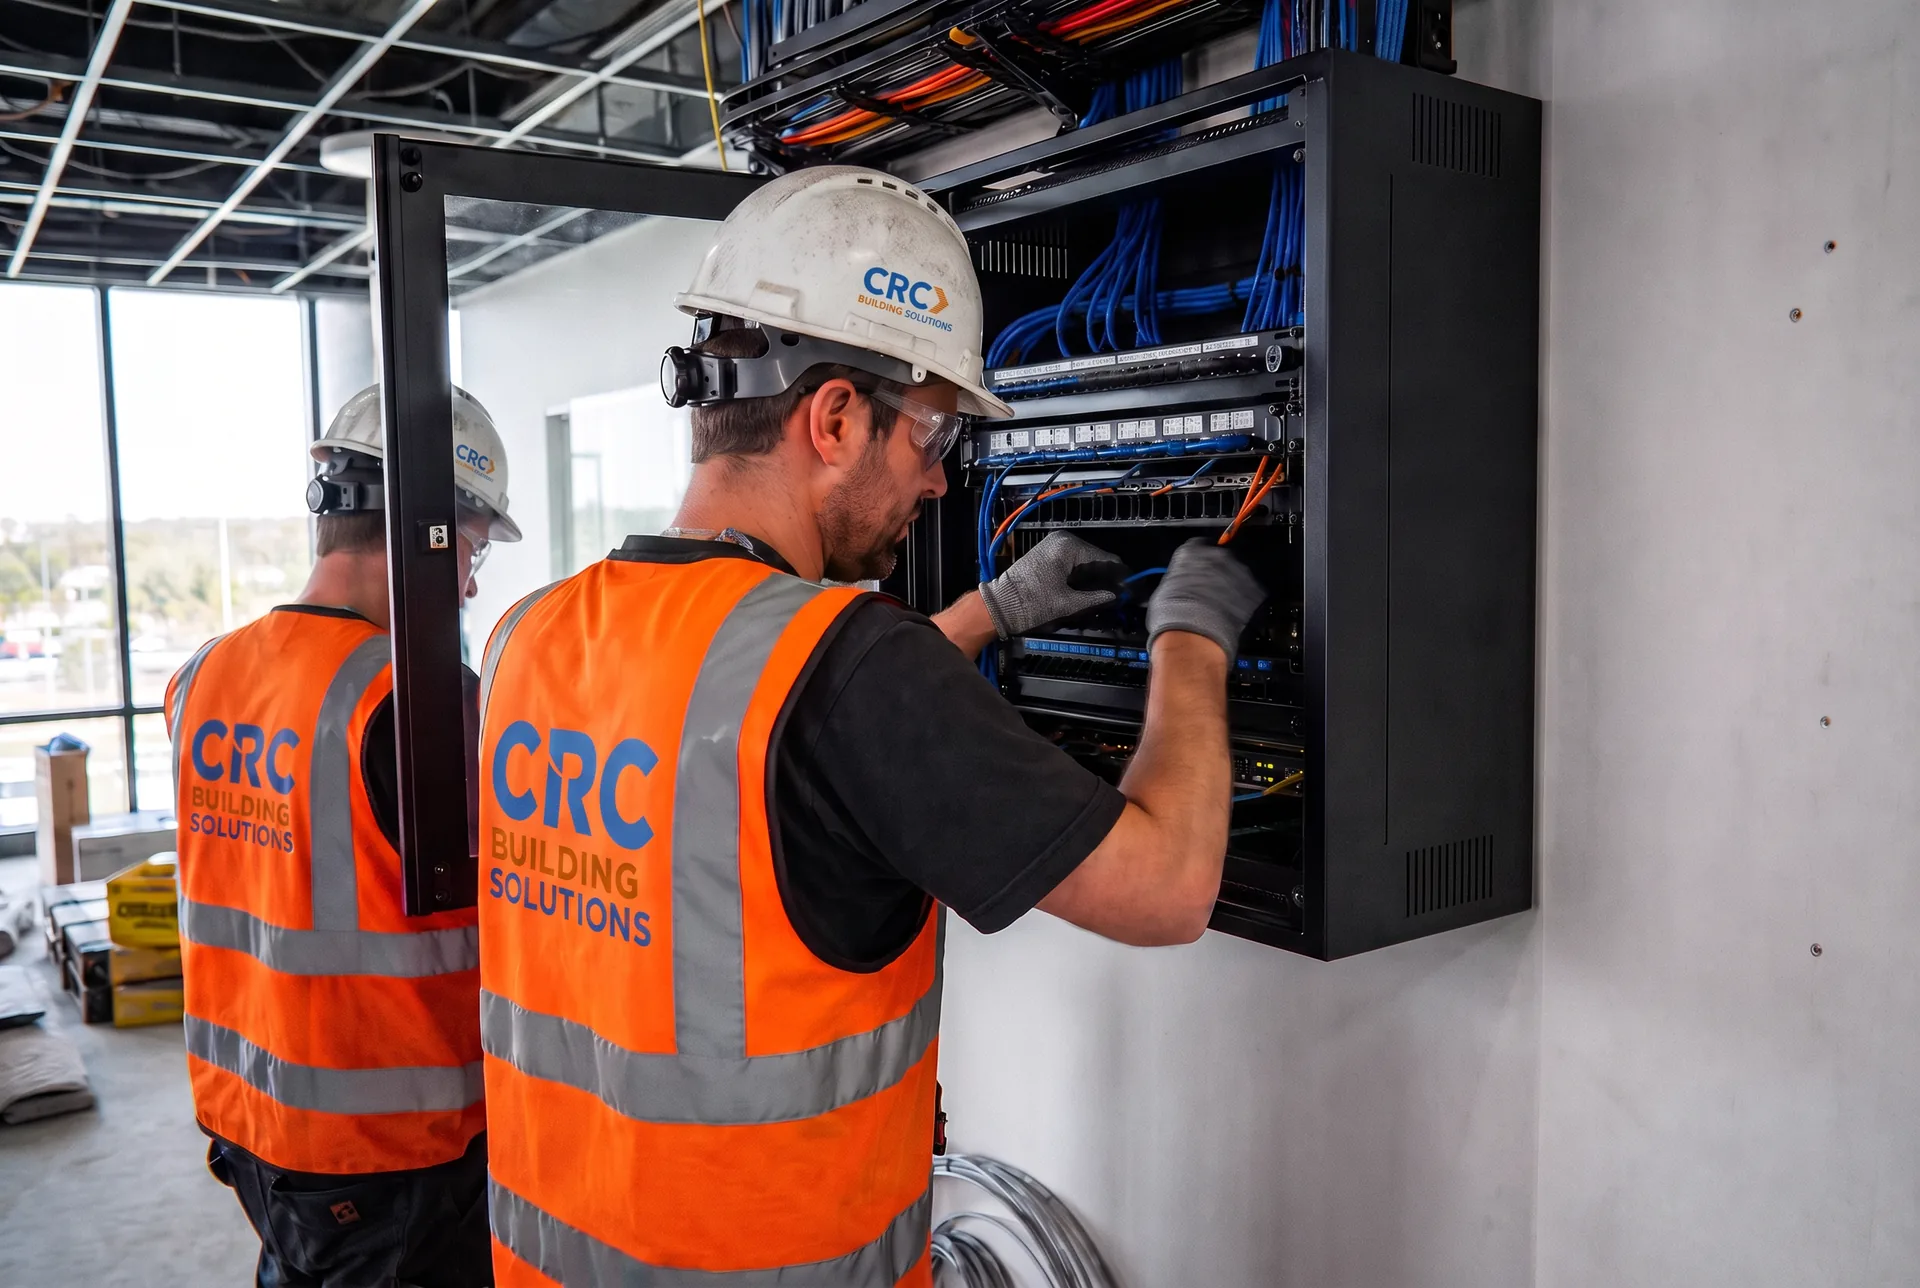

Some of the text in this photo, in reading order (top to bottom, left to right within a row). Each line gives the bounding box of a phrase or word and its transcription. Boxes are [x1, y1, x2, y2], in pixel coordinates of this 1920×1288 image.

[864, 267, 932, 310] CRC
[858, 294, 952, 332] BUILDING SOLUTIONS
[456, 444, 488, 470] CRC
[192, 719, 300, 795] CRC
[192, 786, 289, 826] BUILDING
[493, 720, 659, 850] CRC
[190, 813, 294, 853] SOLUTIONS
[491, 827, 638, 899] BUILDING
[490, 868, 651, 947] SOLUTIONS
